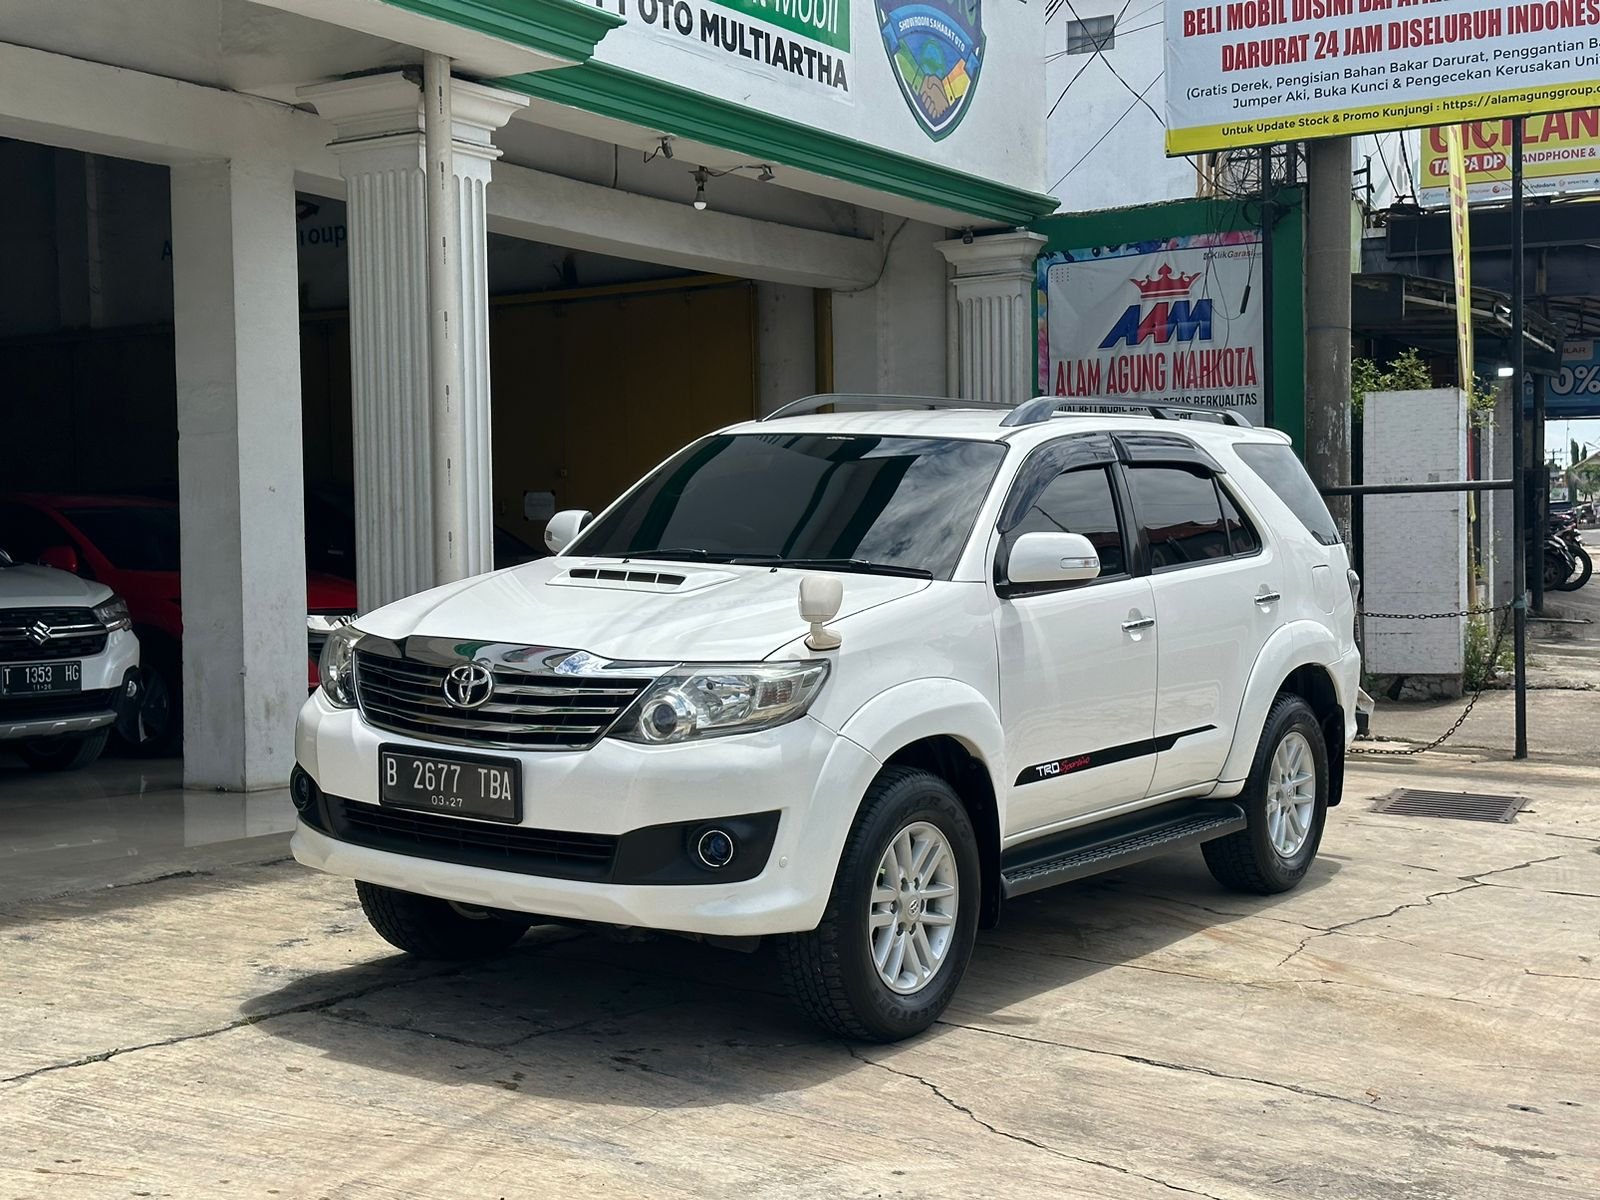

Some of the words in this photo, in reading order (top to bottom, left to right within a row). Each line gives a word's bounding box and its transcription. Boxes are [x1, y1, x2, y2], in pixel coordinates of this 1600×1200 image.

[1183, 6, 1221, 37] BELI
[1227, 0, 1287, 31] MOBIL
[638, 0, 693, 36] OTO
[700, 9, 848, 92] MULTIARTHA
[1222, 34, 1309, 72] DARURAT
[1314, 30, 1339, 60] 24
[1343, 24, 1382, 56] JAM
[1388, 8, 1501, 51] DISELURUH
[1186, 84, 1227, 100] (Gratis
[1277, 68, 1340, 90] Pengisian
[1344, 65, 1385, 79] Bahan
[1390, 59, 1428, 73] Bakar
[1433, 52, 1488, 68] Darurat,
[1493, 39, 1584, 60] Penggantian
[1233, 93, 1282, 109] Jumper
[1314, 86, 1346, 99] Buka
[1351, 80, 1388, 94] Kunci
[1393, 78, 1402, 88] &
[1406, 69, 1491, 87] Pengecekan
[1496, 58, 1570, 77] Kerusakan
[1222, 122, 1253, 136] Untuk
[1256, 120, 1296, 135] Update
[1298, 114, 1329, 127] Stock
[1332, 113, 1340, 123] &
[1343, 109, 1379, 122] Promo
[1382, 103, 1433, 117] Kunjungi
[1483, 154, 1504, 169] DP
[1522, 148, 1586, 164] ANDPHONE
[1588, 147, 1596, 157] &
[1097, 299, 1212, 349] AAM
[1055, 358, 1100, 397] ALAM
[1106, 352, 1166, 394] AGUNG
[1173, 346, 1257, 390] MAHKOTA
[1194, 393, 1257, 407] BERKUALITAS
[4, 668, 11, 685] T
[25, 666, 53, 684] 1353
[65, 665, 79, 681] HG
[387, 758, 397, 786] B
[413, 761, 461, 793] 2677
[478, 767, 511, 801] TBA
[1036, 761, 1060, 776] TRD
